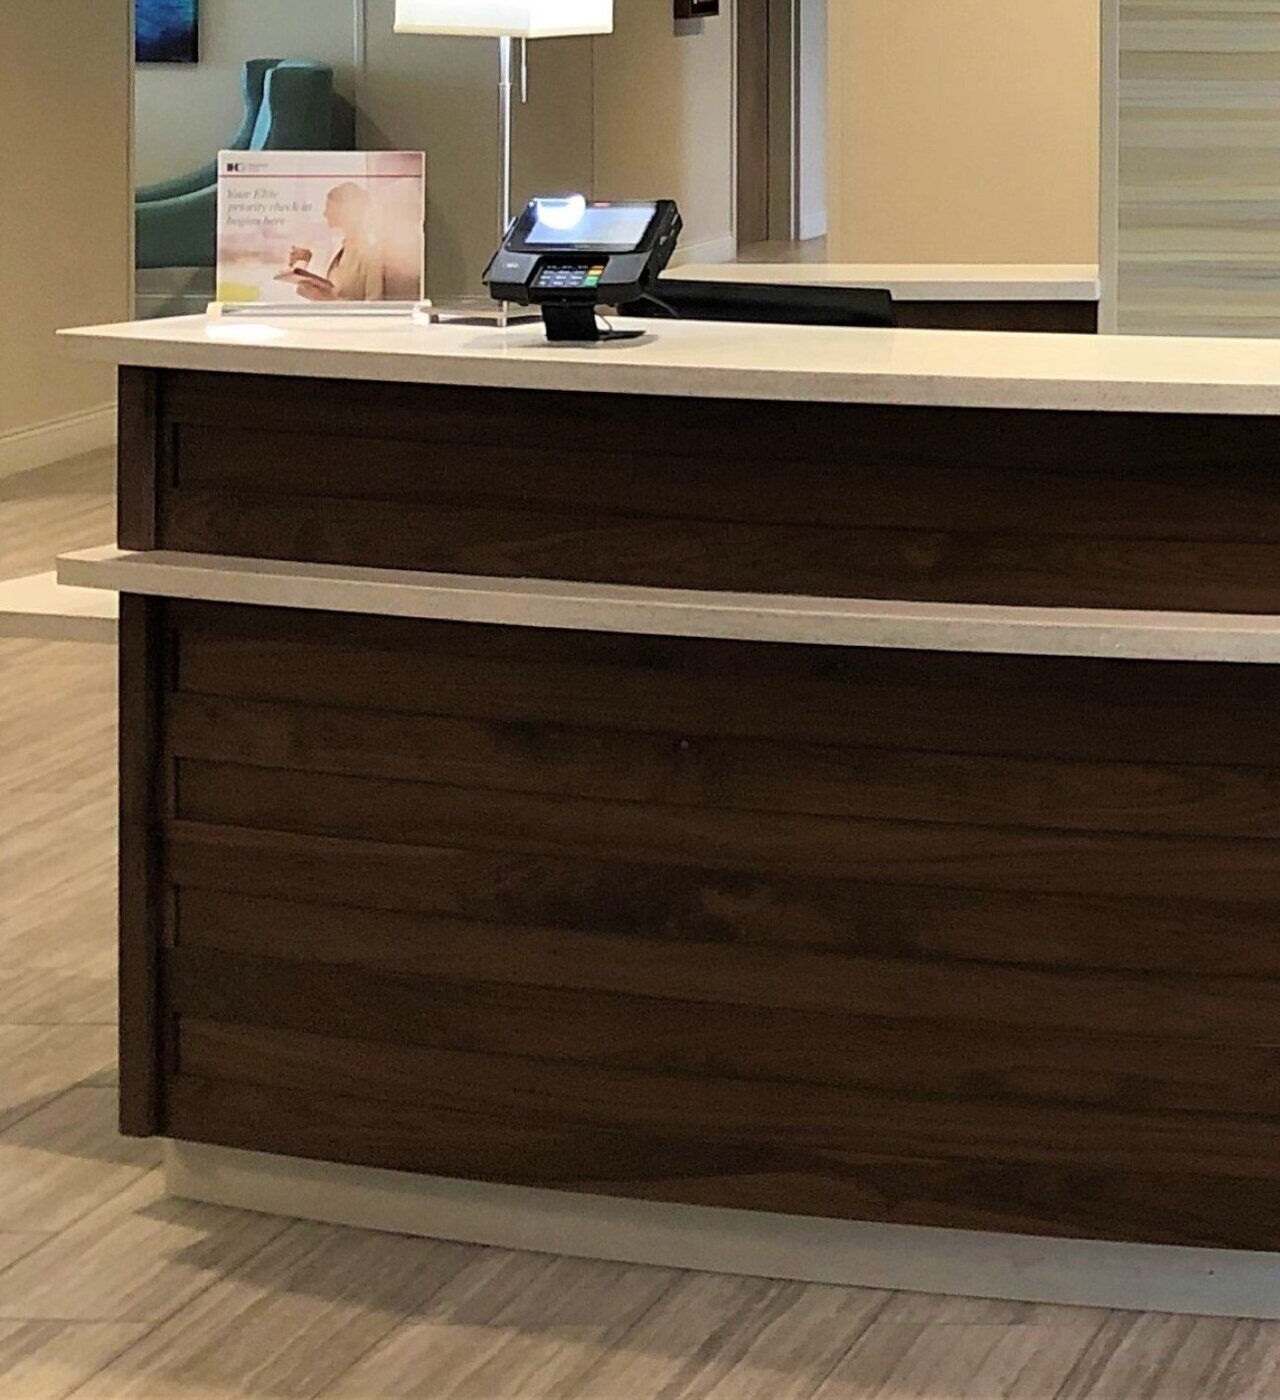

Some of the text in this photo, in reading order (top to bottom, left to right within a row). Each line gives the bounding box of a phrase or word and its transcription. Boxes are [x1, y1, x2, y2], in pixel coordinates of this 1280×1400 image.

[227, 188, 251, 200] Your
[227, 202, 267, 214] priority
[263, 216, 286, 226] here
